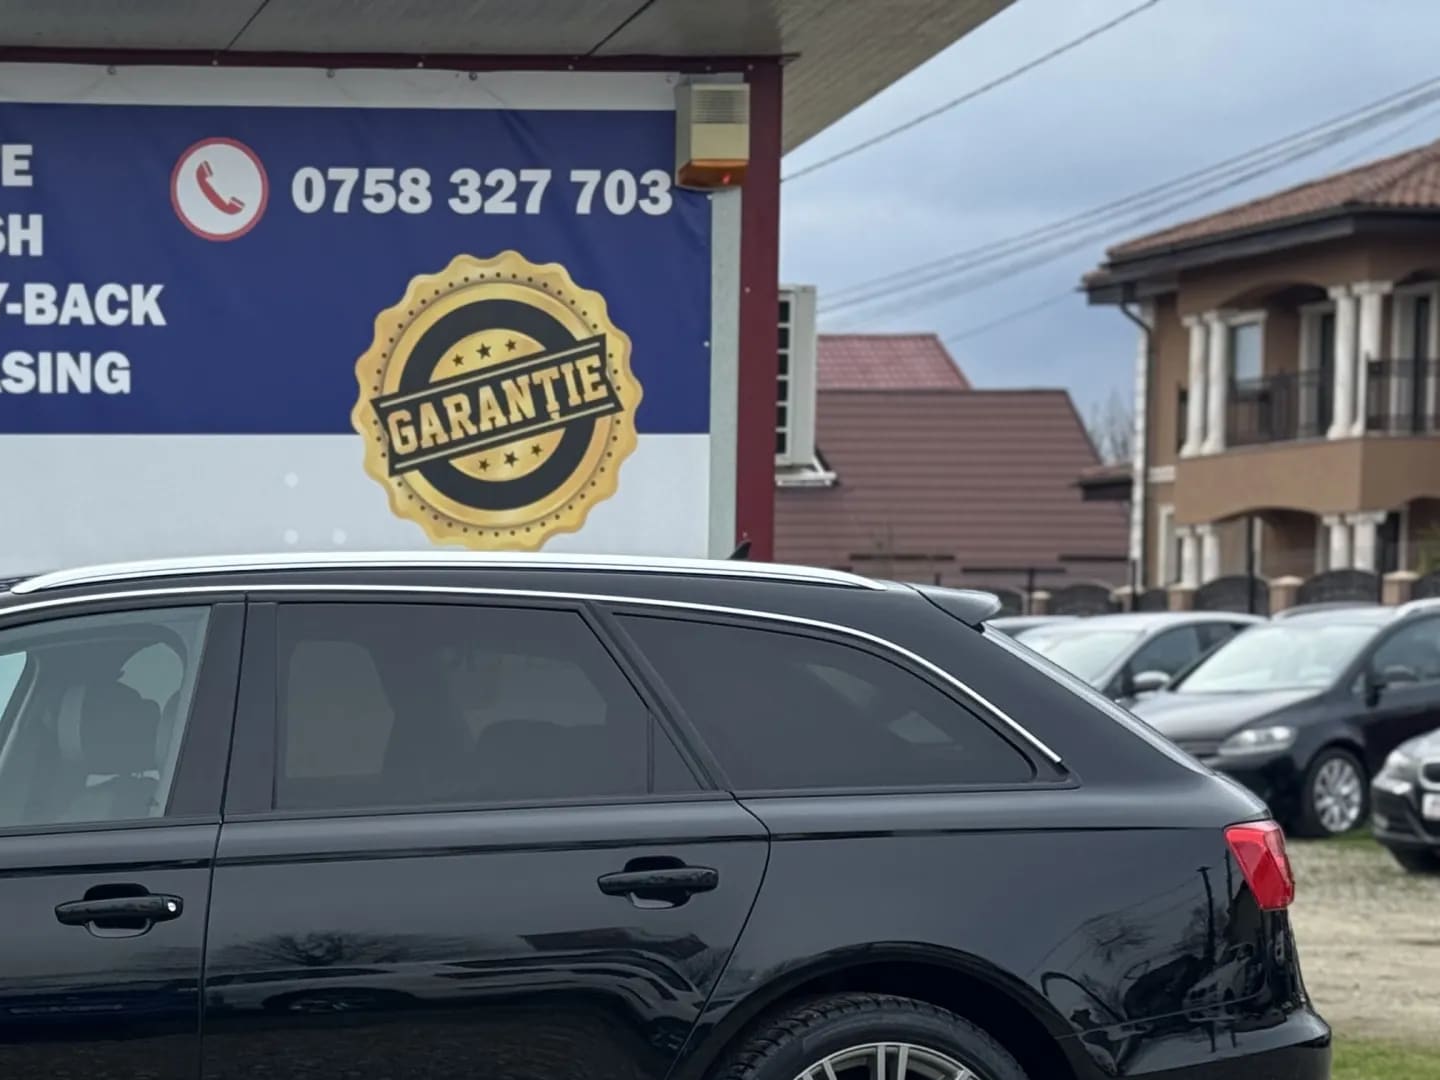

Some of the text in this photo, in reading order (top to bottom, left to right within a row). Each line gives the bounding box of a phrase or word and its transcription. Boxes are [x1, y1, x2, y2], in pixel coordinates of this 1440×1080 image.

[291, 166, 673, 216] 0758 327 703
